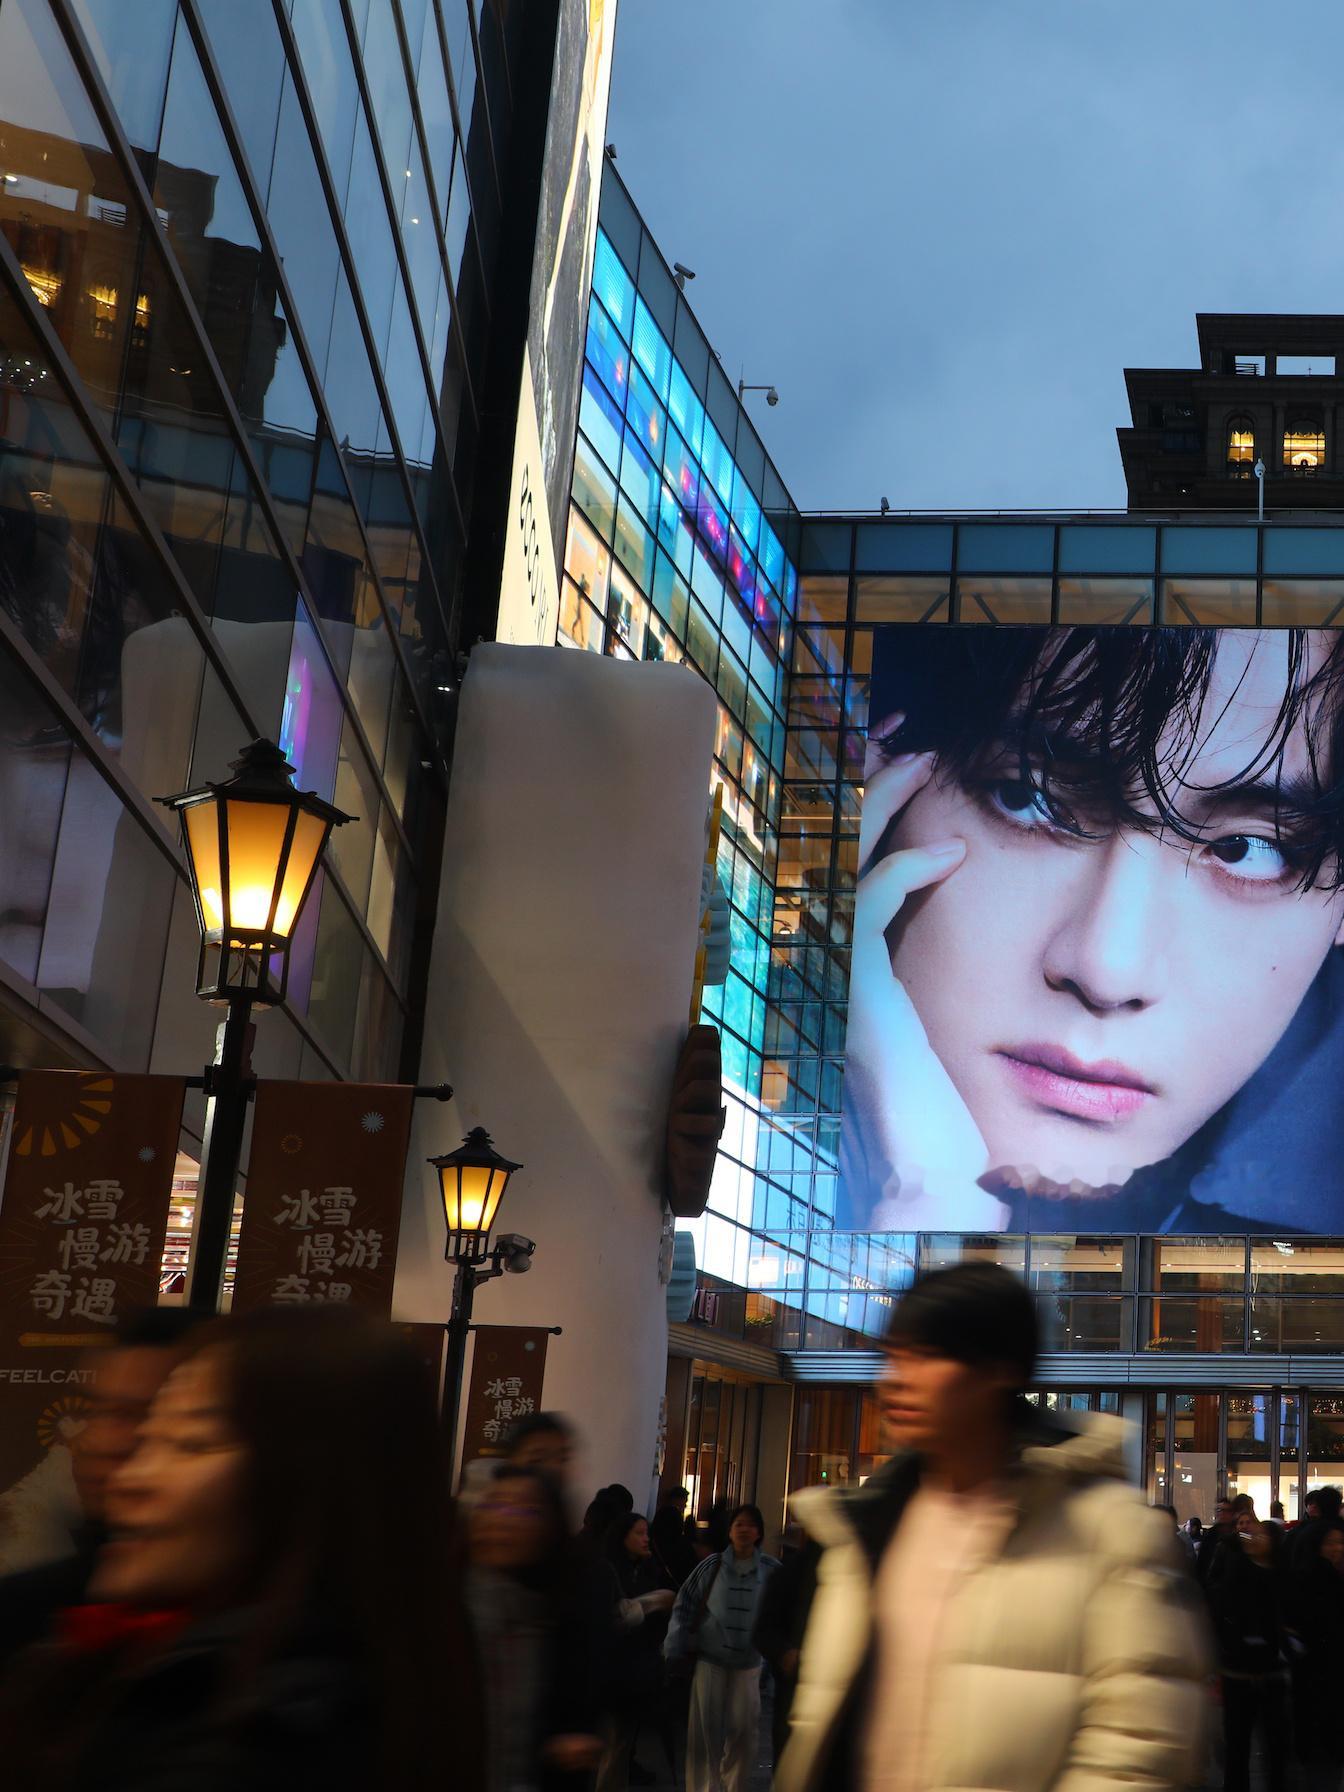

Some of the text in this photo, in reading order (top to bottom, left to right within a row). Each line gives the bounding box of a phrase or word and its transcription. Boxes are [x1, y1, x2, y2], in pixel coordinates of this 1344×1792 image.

[35, 1180, 124, 1223] 冰雪
[273, 1187, 357, 1229] 冰雪
[59, 1223, 150, 1271] 慢游
[296, 1229, 383, 1276] 慢游
[30, 1270, 118, 1325] 奇遇
[0, 1369, 97, 1384] FEELCATI
[483, 1377, 523, 1398] 冰雪
[495, 1397, 534, 1419] 慢游
